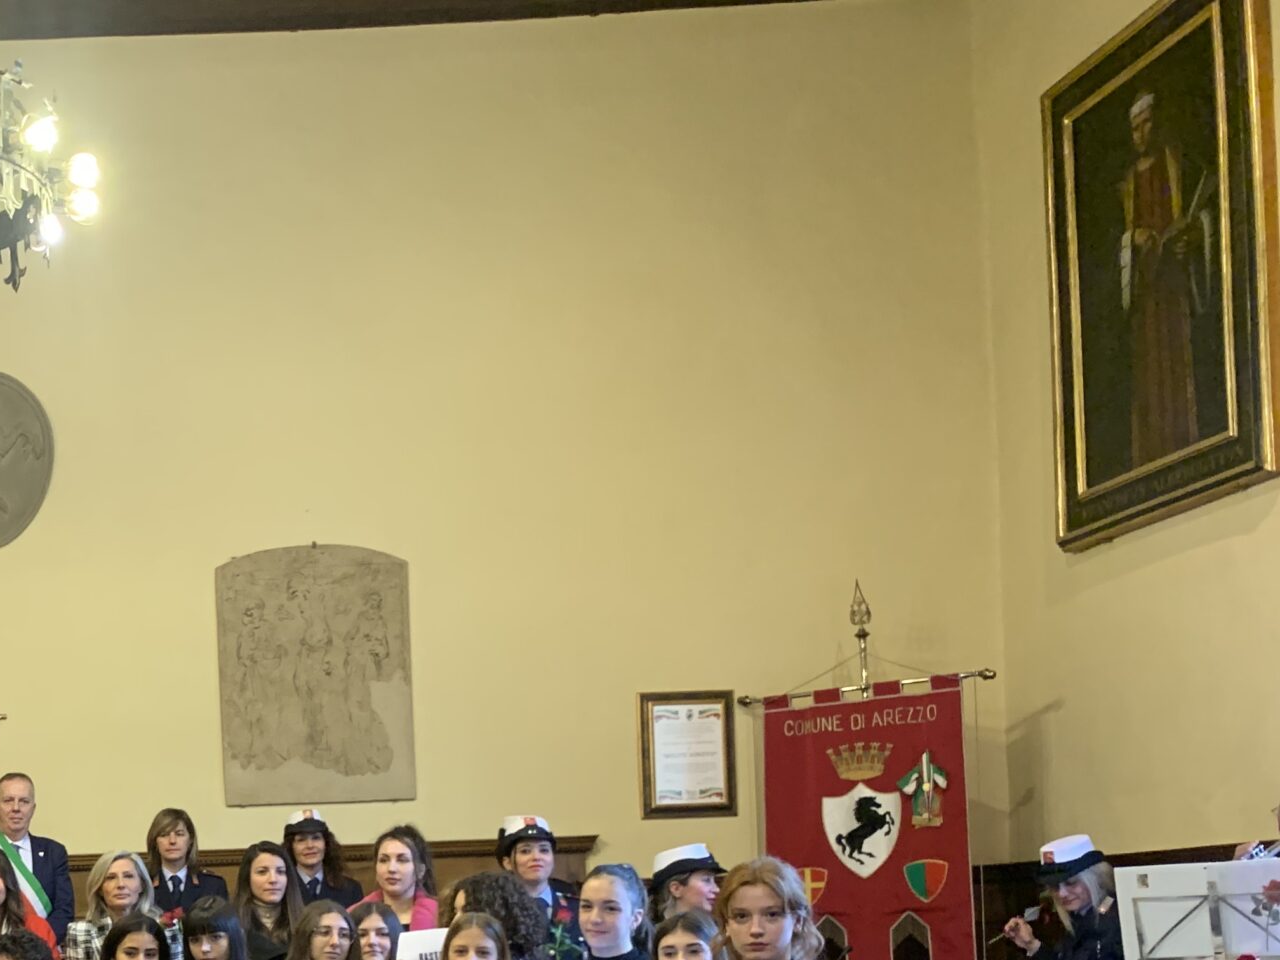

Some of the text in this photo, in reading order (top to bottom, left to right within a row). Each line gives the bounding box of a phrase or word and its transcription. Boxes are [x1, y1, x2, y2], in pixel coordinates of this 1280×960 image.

[784, 704, 937, 737] COMUNE DI AREZZO
